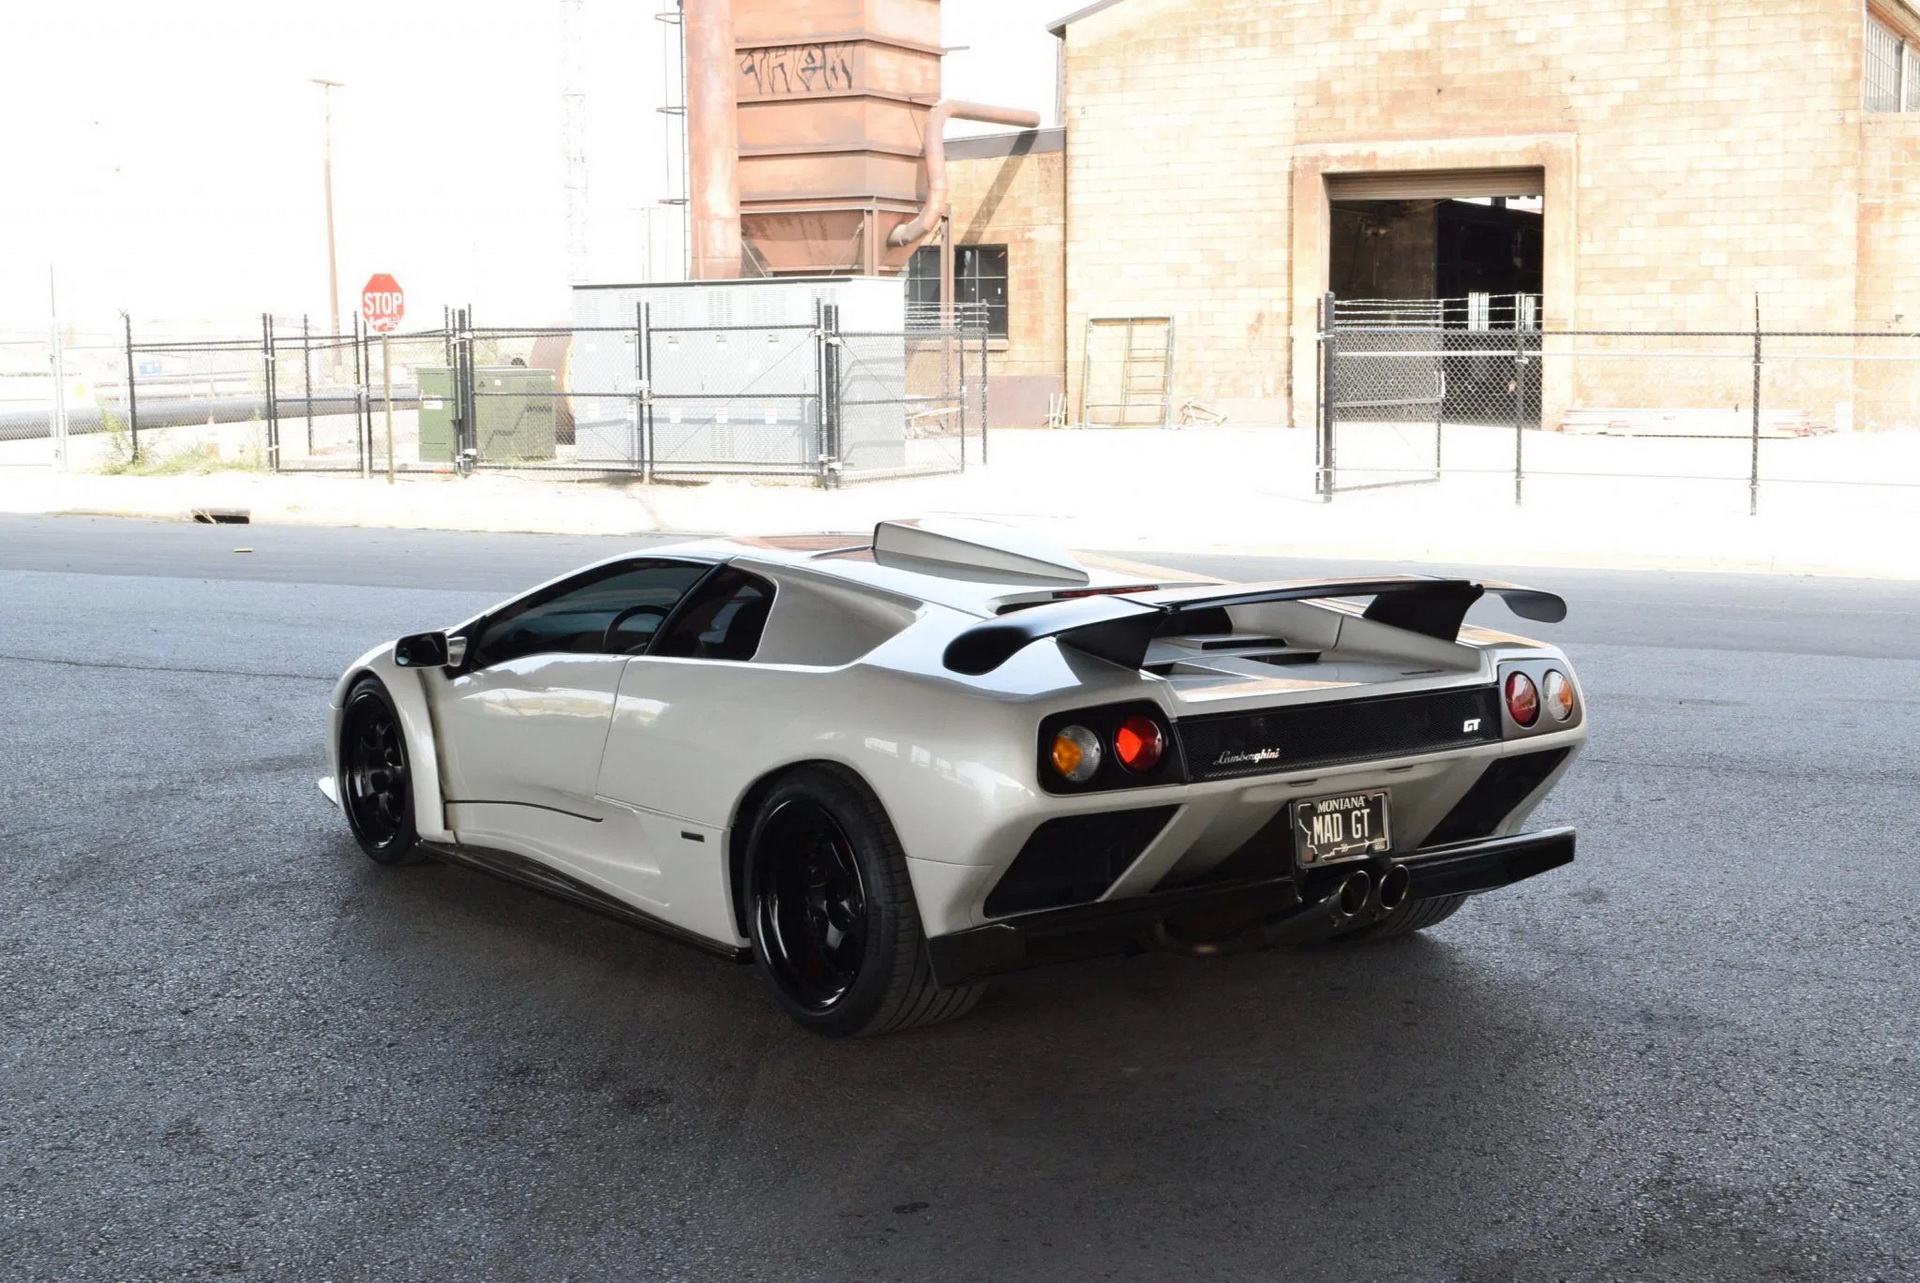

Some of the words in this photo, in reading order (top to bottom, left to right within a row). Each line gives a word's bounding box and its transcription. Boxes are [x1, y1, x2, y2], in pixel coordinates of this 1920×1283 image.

[364, 291, 403, 315] STOP
[1463, 718, 1481, 732] GT
[1213, 747, 1280, 765] Lamborghini
[1317, 796, 1366, 813] MONTANA
[1313, 813, 1343, 845] MAD
[1351, 808, 1371, 839] GT
